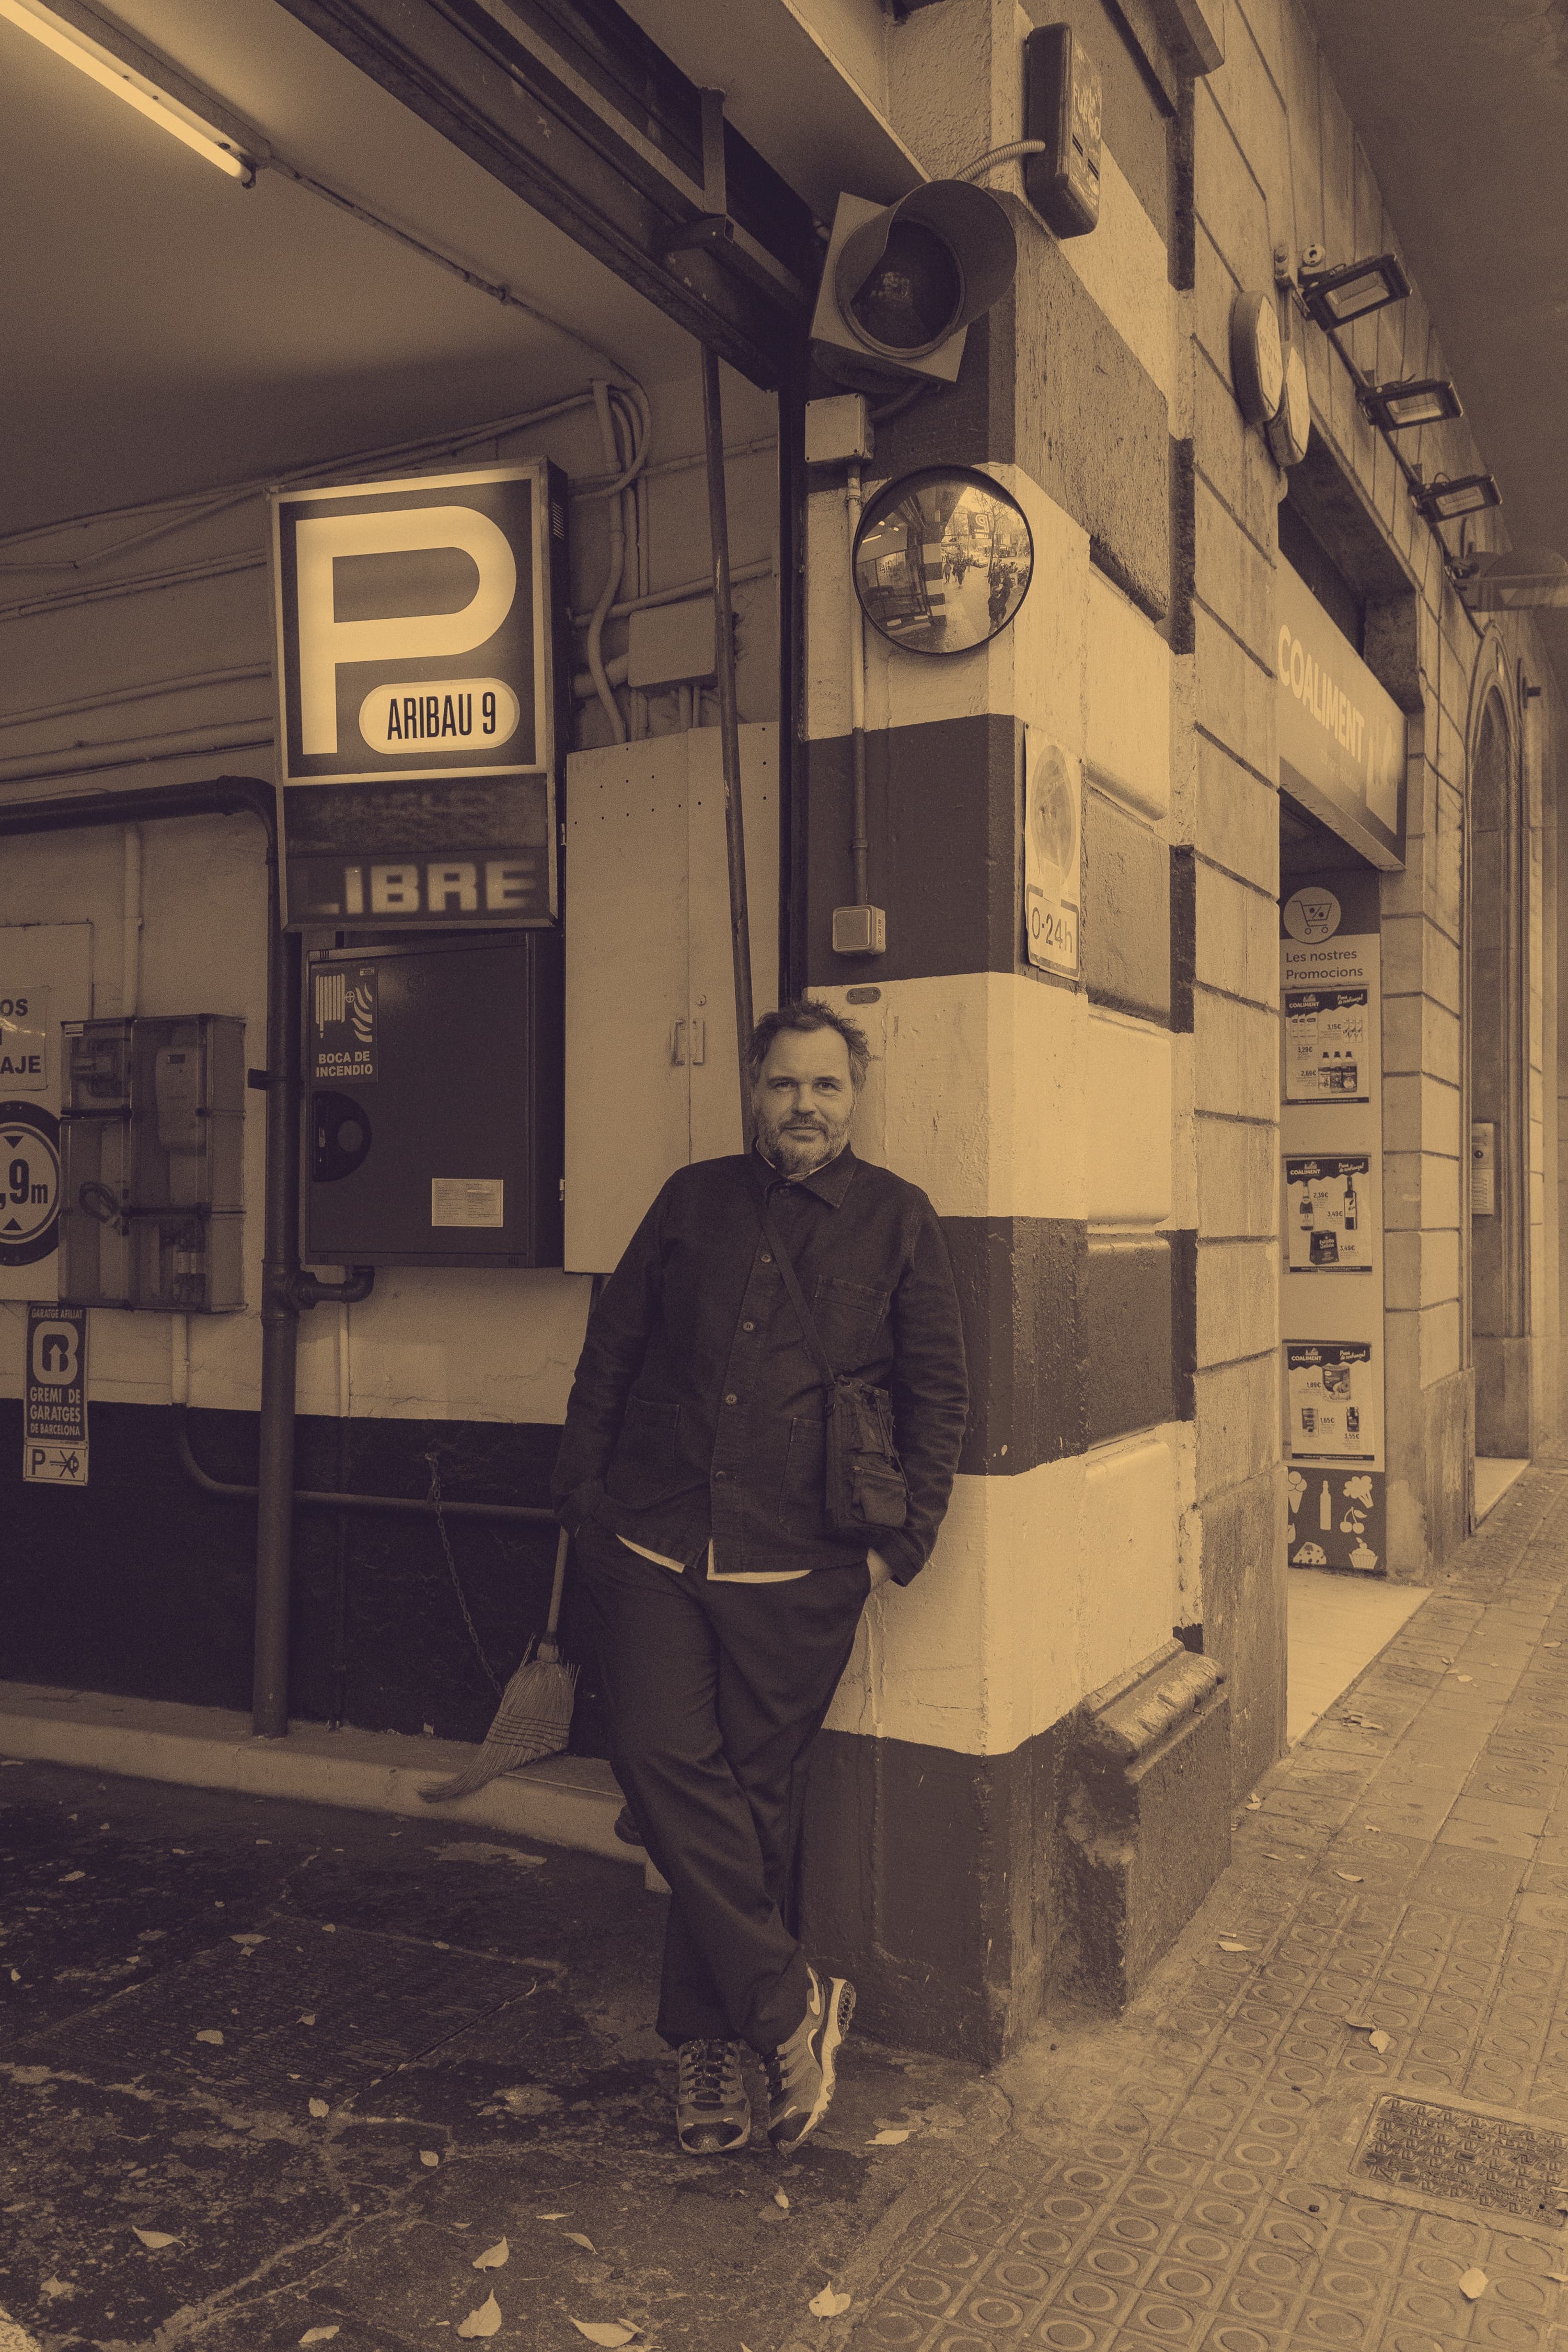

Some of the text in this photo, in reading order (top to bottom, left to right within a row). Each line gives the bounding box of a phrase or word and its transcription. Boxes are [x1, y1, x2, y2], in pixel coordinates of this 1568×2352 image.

[296, 505, 516, 755] P
[1278, 624, 1365, 764] COALIMENT
[387, 691, 496, 740] ARIBAU 9
[313, 861, 535, 915] IBRE
[1286, 950, 1357, 963] Les nostres
[1286, 967, 1363, 980] Promocions
[319, 1051, 370, 1064] BOCA DE
[316, 1064, 373, 1077] INCENDIO
[32, 1309, 84, 1319] GARATGE AFILIAT
[30, 1387, 80, 1404] GREMI DE
[30, 1404, 80, 1422] GARATGES
[30, 1423, 80, 1436] DE BARCELONA
[31, 1449, 45, 1475] P
